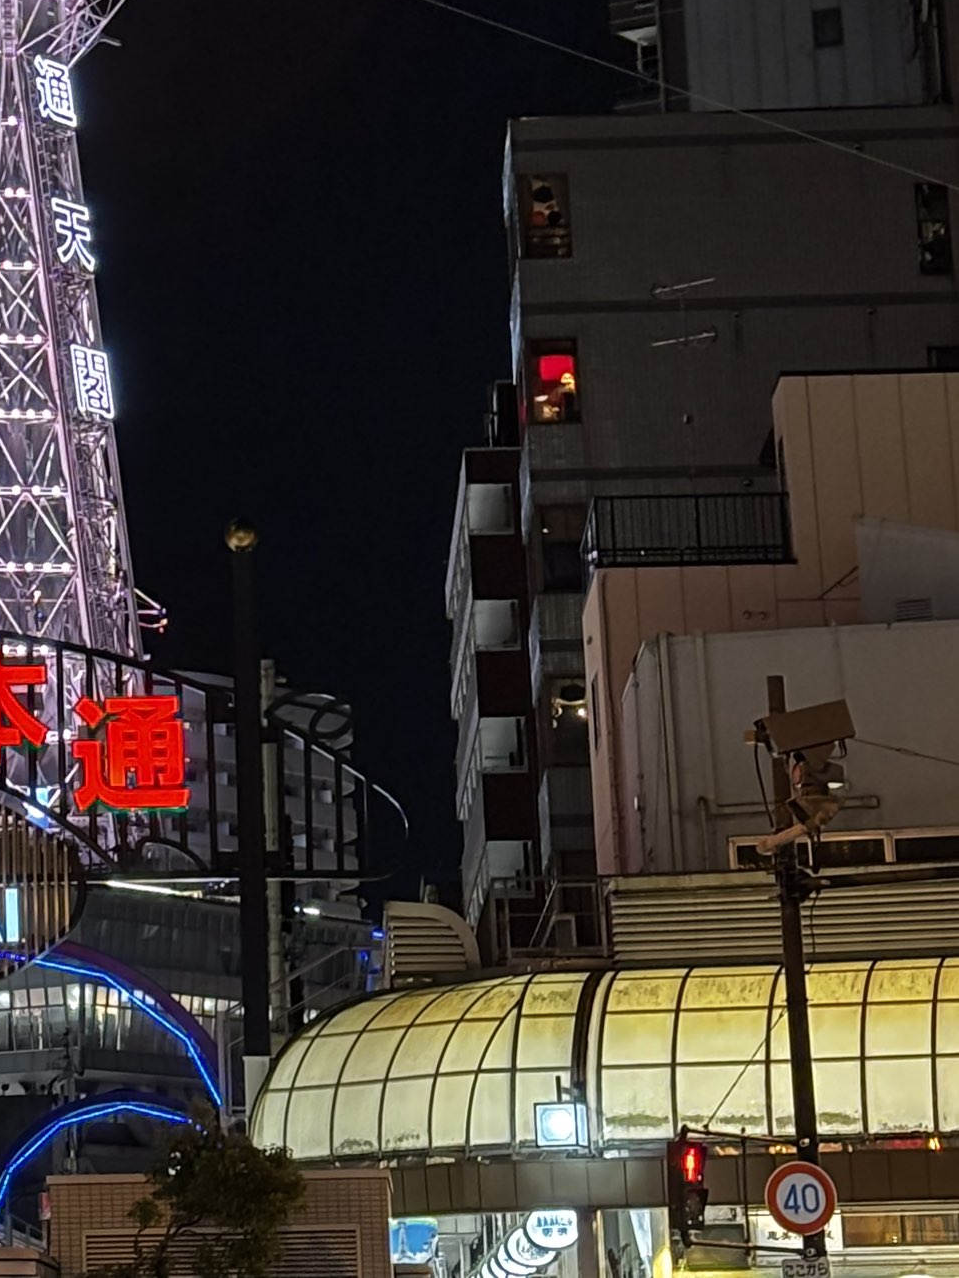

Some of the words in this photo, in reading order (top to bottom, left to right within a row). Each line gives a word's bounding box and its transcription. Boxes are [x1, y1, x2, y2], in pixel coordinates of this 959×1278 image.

[34, 54, 114, 418] 通天閣
[784, 1183, 820, 1215] 40
[784, 1263, 829, 1278] ここから
